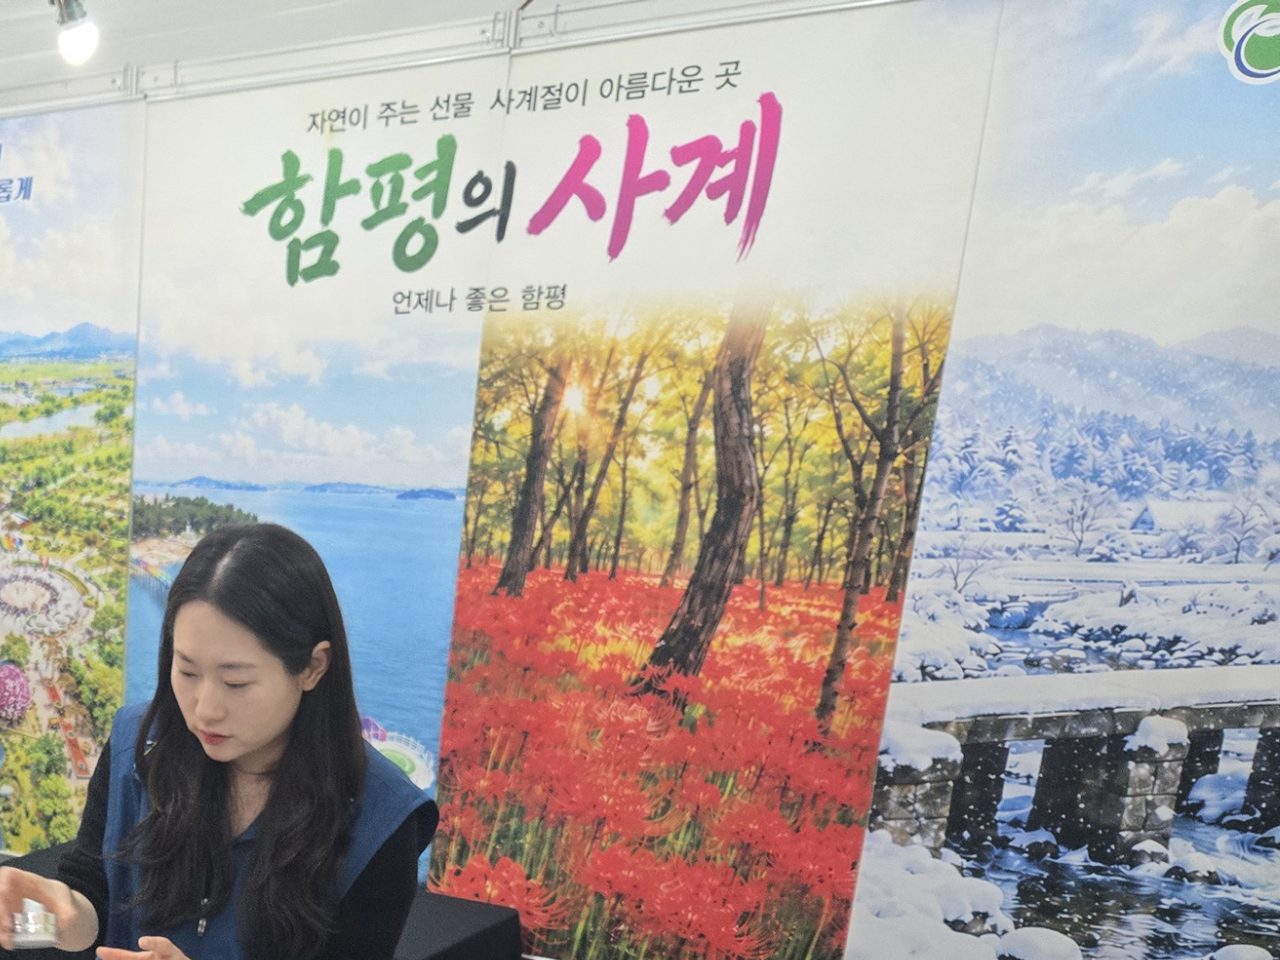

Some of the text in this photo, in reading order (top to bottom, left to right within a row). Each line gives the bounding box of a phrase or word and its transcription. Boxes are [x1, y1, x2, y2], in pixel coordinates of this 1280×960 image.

[306, 59, 743, 135] 자연이 주는 선물 사계절이 아름다운 곳
[241, 91, 783, 287] 함평의 사계
[392, 283, 568, 316] 언제나 좋은 함평
